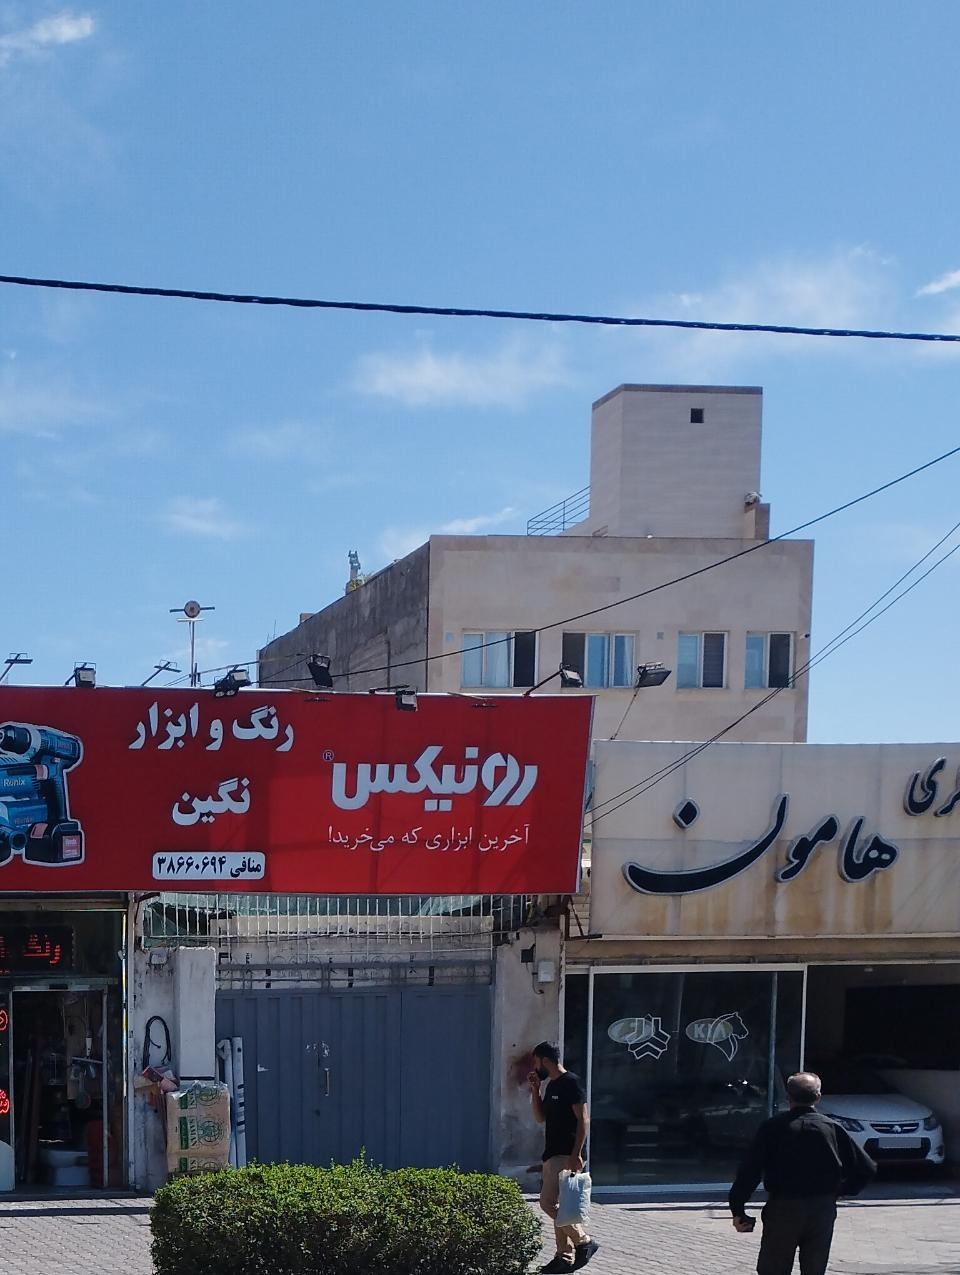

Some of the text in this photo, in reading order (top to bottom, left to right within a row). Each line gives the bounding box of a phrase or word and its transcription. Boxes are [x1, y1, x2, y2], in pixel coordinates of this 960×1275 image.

[128, 701, 295, 752] رنگ و ابزار
[3, 776, 27, 788] Ronix
[330, 745, 539, 812] رونیکس
[172, 776, 251, 827] نگین
[401, 826, 423, 844] که
[425, 826, 473, 851] ابزاری
[478, 823, 531, 852] آخرین
[623, 793, 900, 896] هامون
[157, 855, 262, 878] منافی ۳۸۶۶۰۶۹۴
